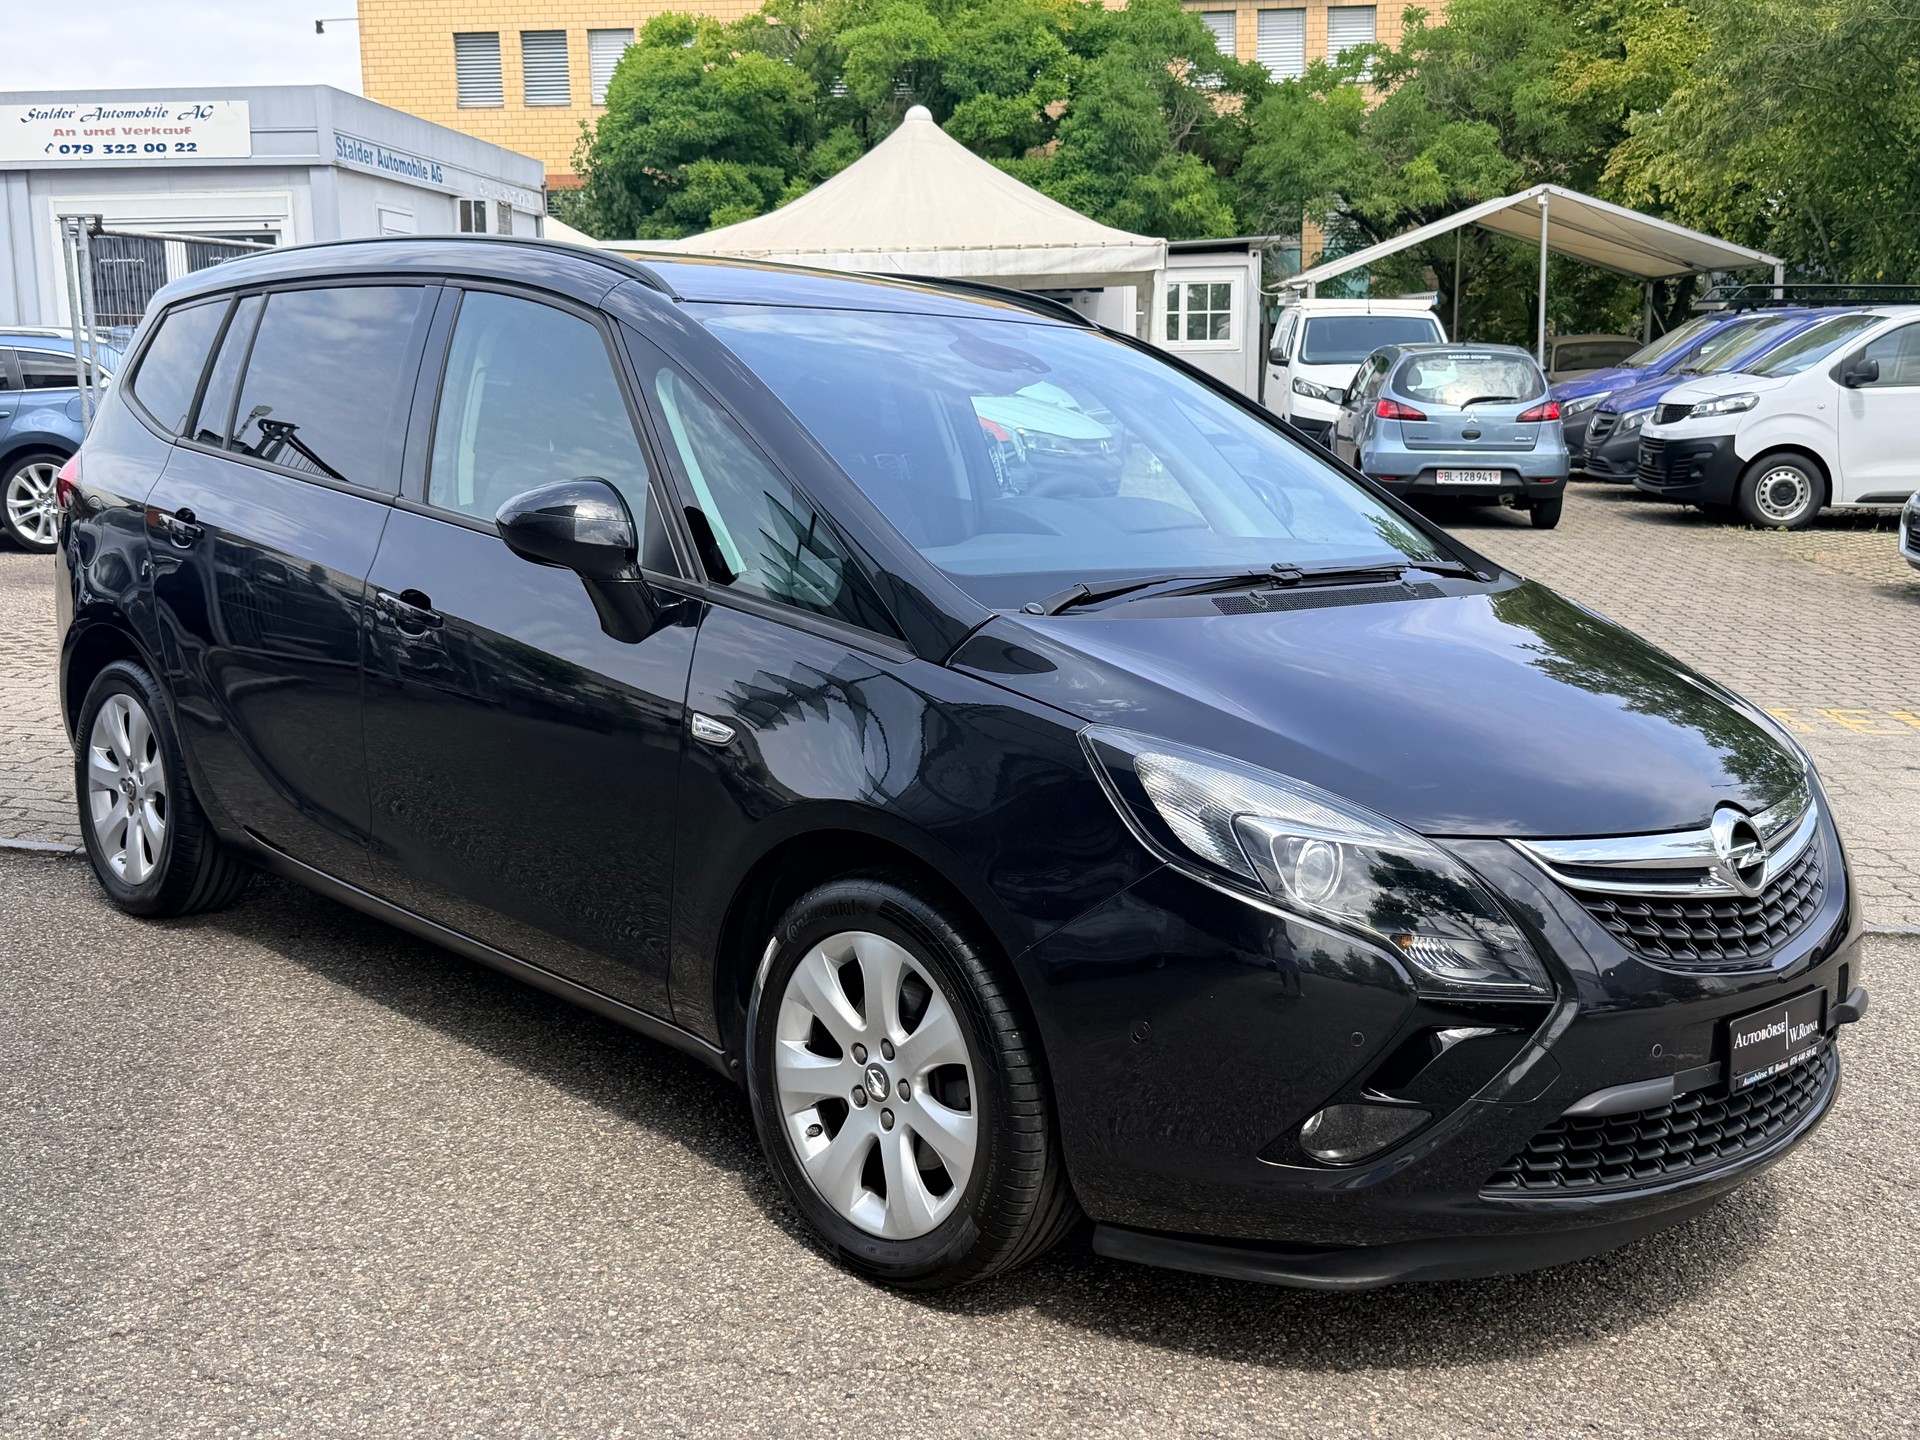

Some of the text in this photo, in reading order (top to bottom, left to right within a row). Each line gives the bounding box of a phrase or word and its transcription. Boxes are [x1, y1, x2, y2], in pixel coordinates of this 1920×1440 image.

[20, 104, 214, 123] Stalder Automobile AG
[53, 126, 192, 137] An und Verkauf
[58, 142, 198, 154] 079 322 00 22
[335, 135, 443, 184] Stalder Automobile AG
[1733, 1021, 1786, 1049] AUTOBÖRSE
